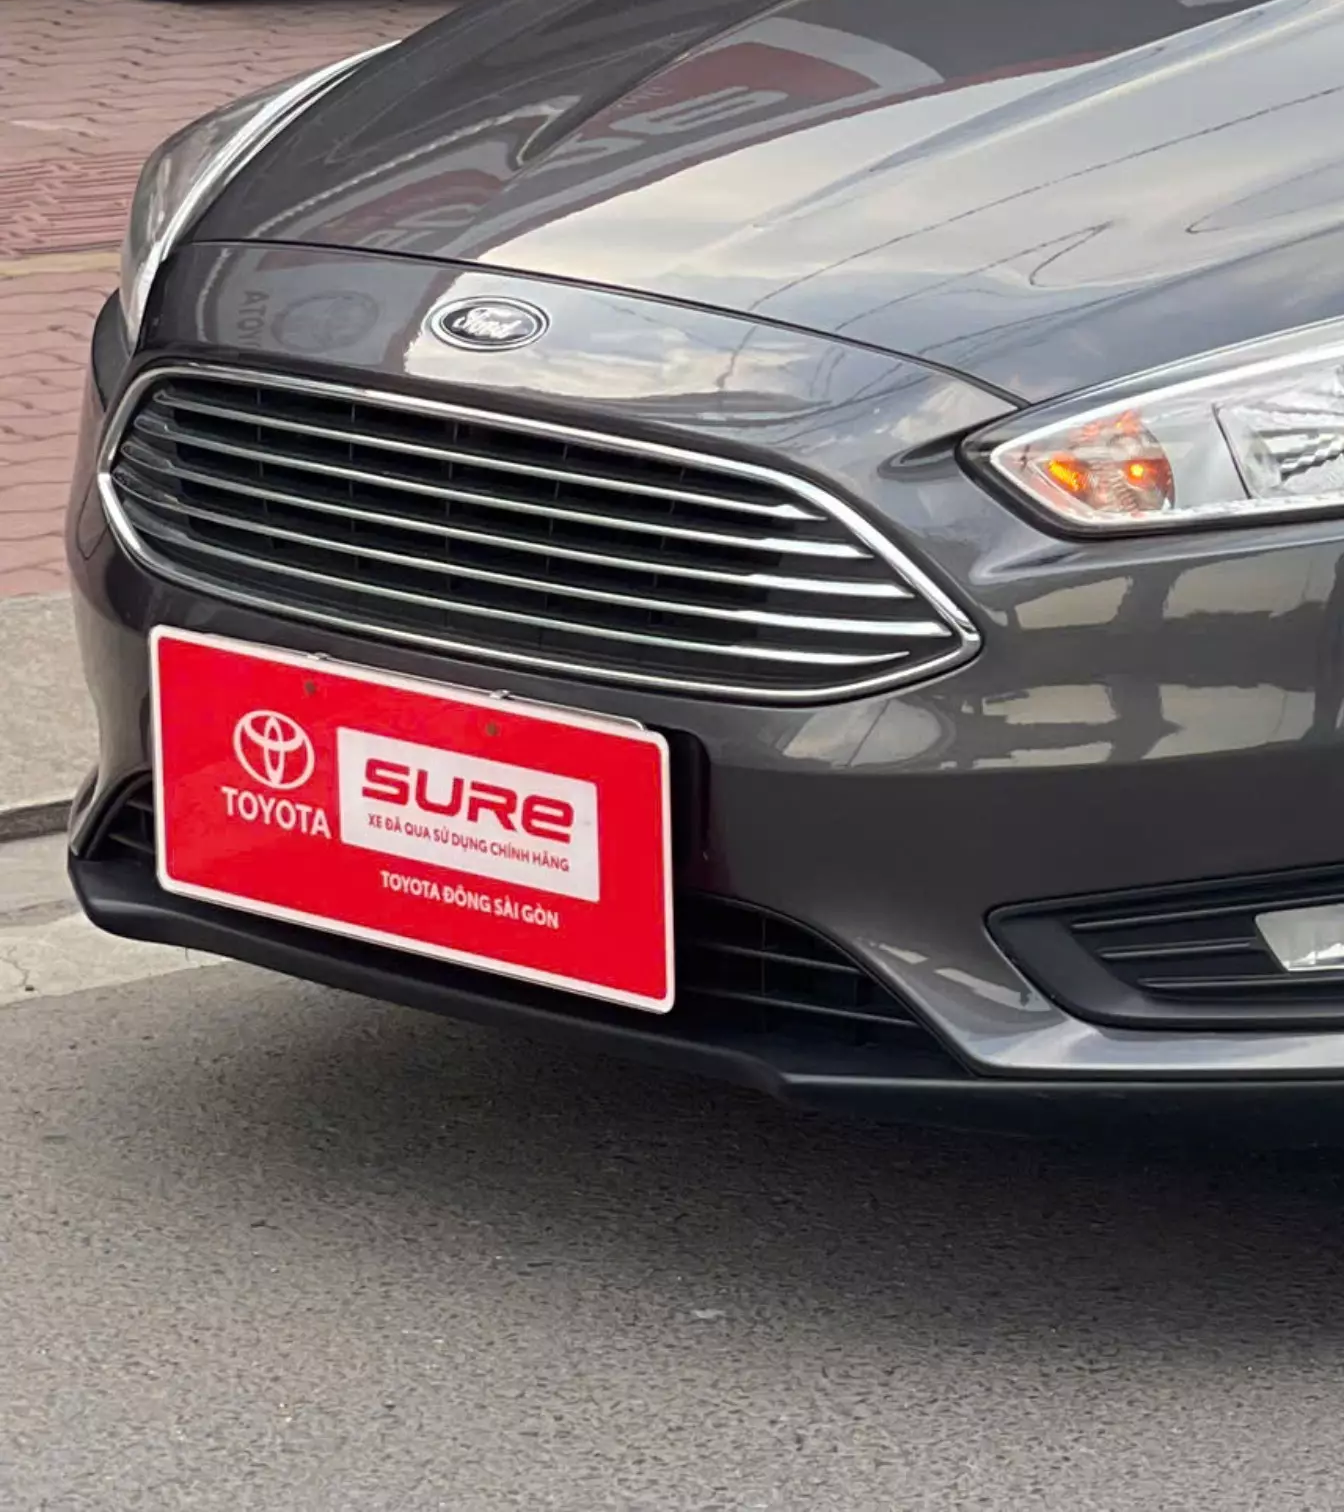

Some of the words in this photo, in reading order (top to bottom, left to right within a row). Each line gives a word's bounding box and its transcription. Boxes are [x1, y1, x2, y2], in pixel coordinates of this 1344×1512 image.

[453, 306, 523, 341] Ford
[221, 785, 332, 840] TOYOTA
[368, 813, 383, 829] XE
[404, 822, 430, 839] QUA
[434, 826, 451, 844] SỬ
[452, 833, 488, 853] DỤNG
[490, 841, 530, 864] CHÍNH
[380, 869, 441, 902] TOYOTA
[443, 885, 492, 914] ĐÔNG
[521, 903, 560, 929] GÒN
